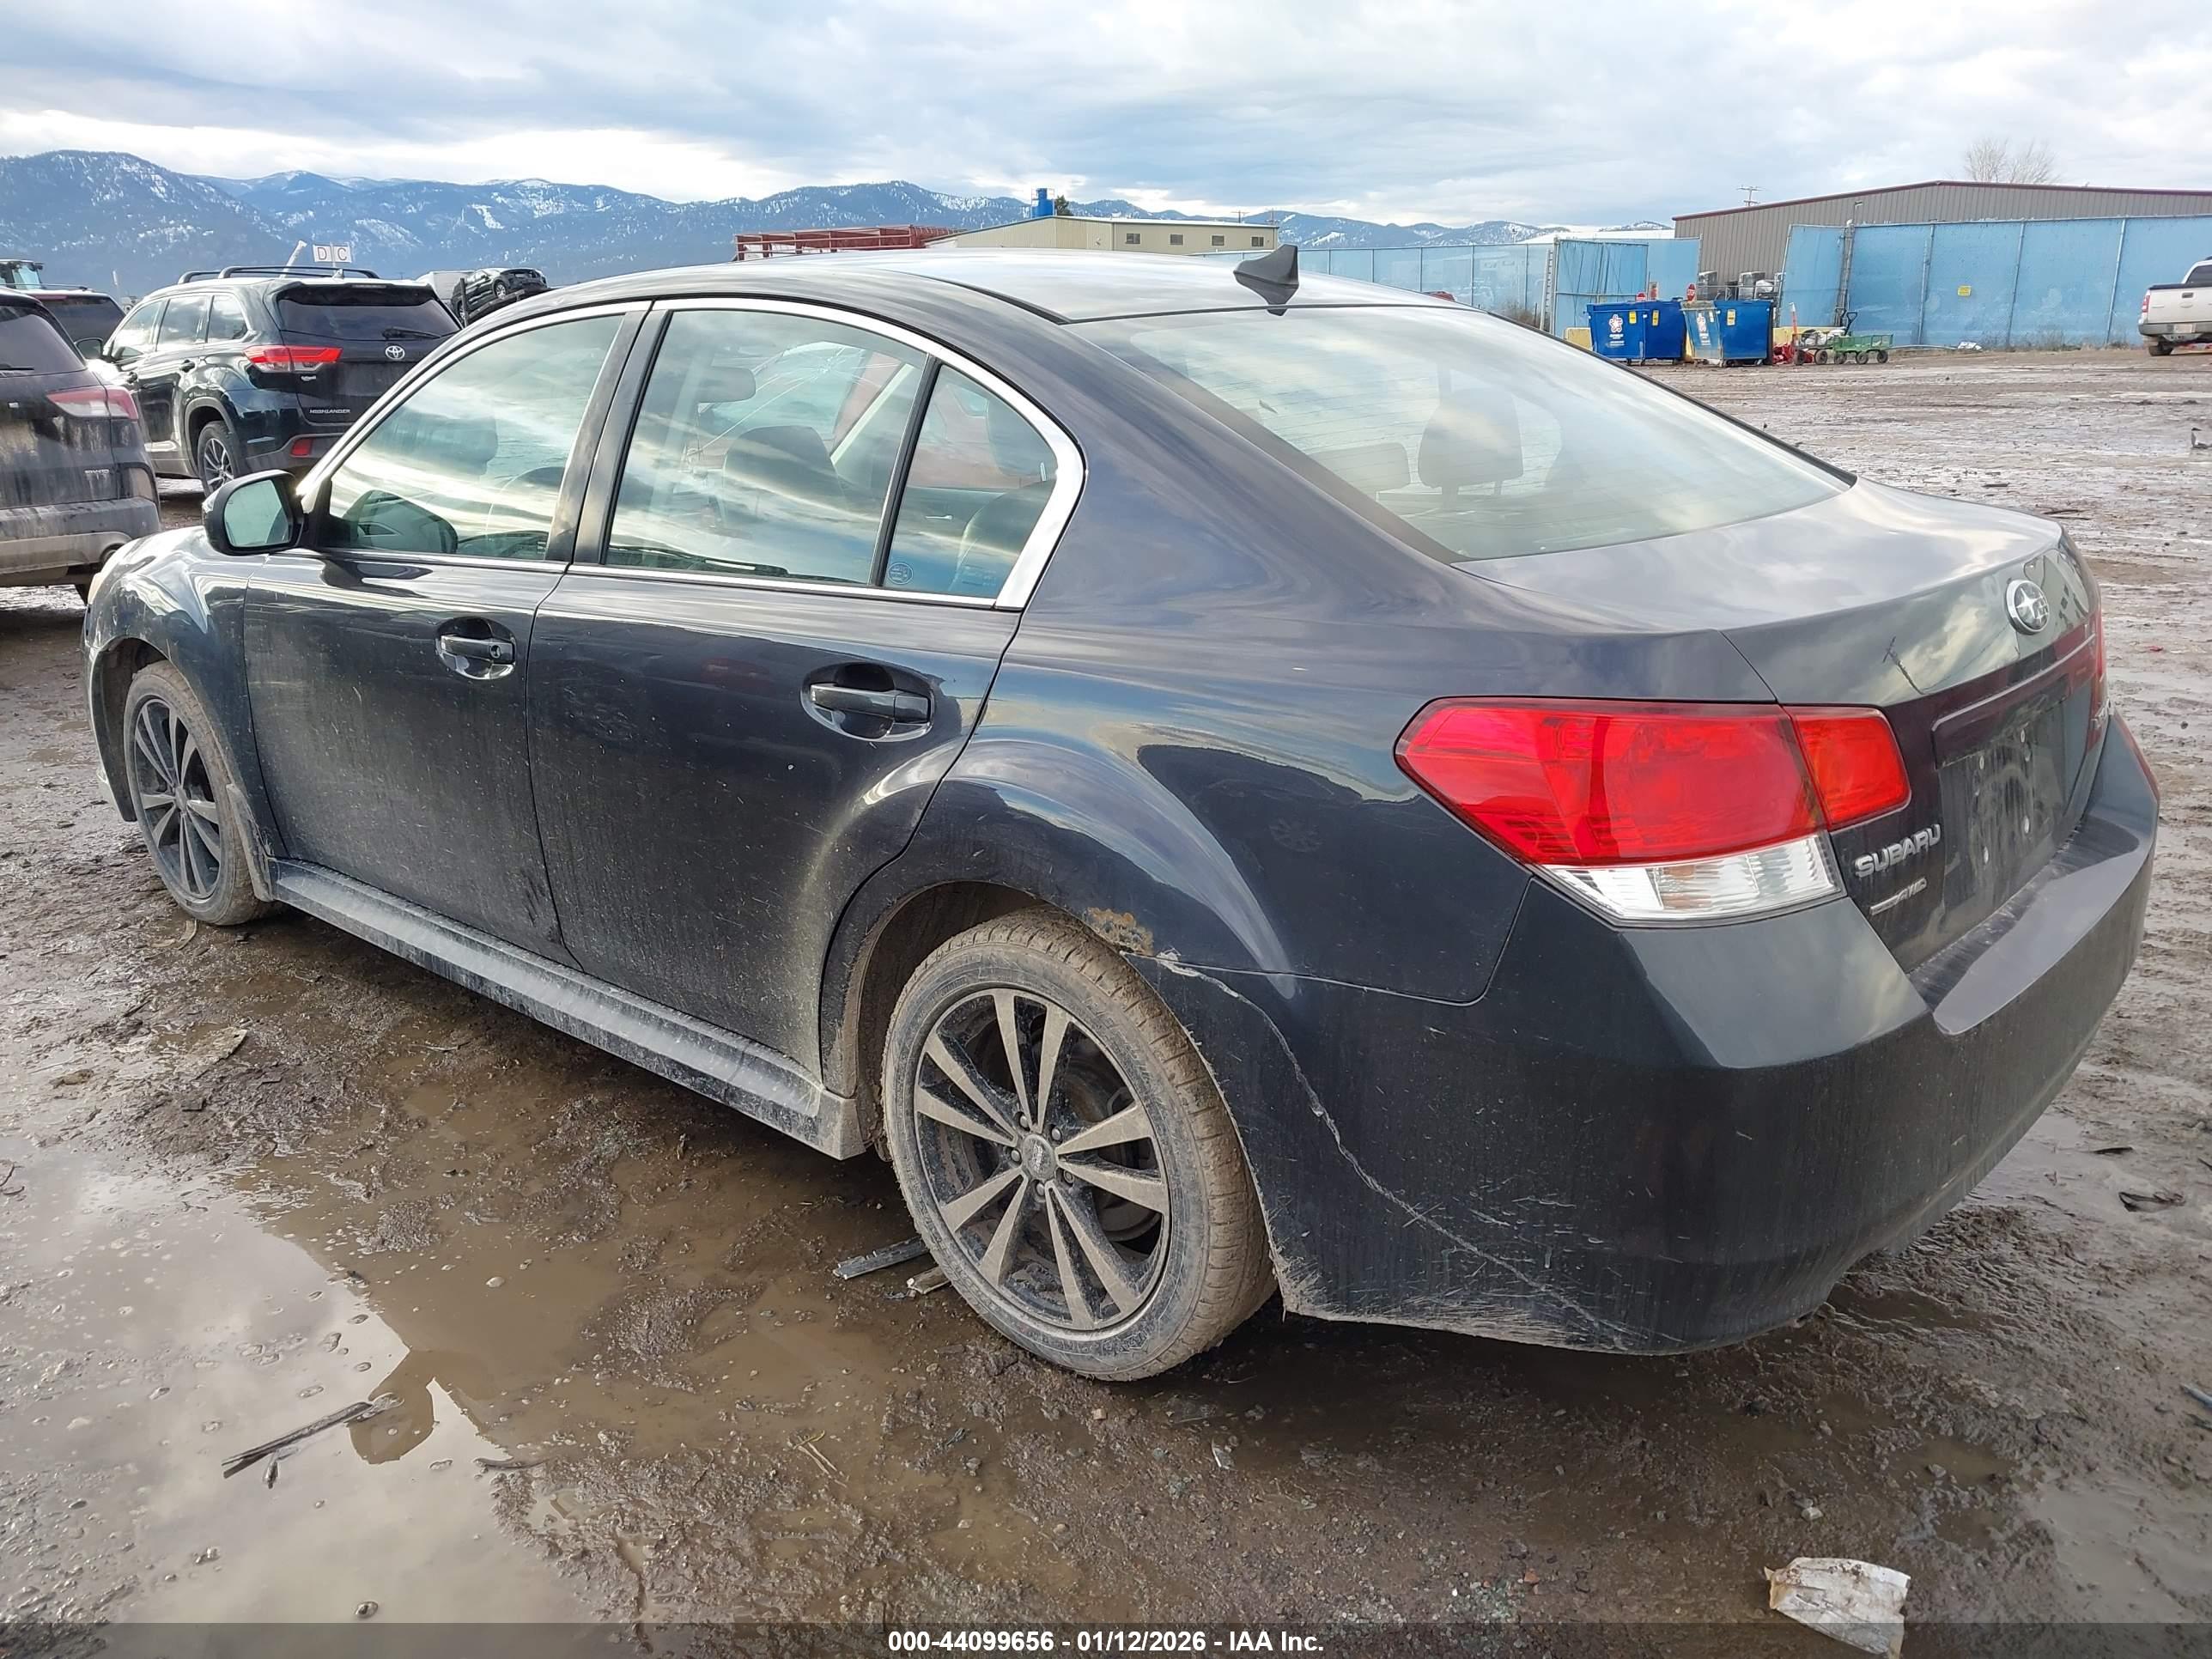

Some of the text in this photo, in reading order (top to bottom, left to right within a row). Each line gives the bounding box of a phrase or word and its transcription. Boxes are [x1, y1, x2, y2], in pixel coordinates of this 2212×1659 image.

[317, 246, 327, 260] D
[337, 247, 347, 261] C
[1855, 823, 1941, 878] SUBARU
